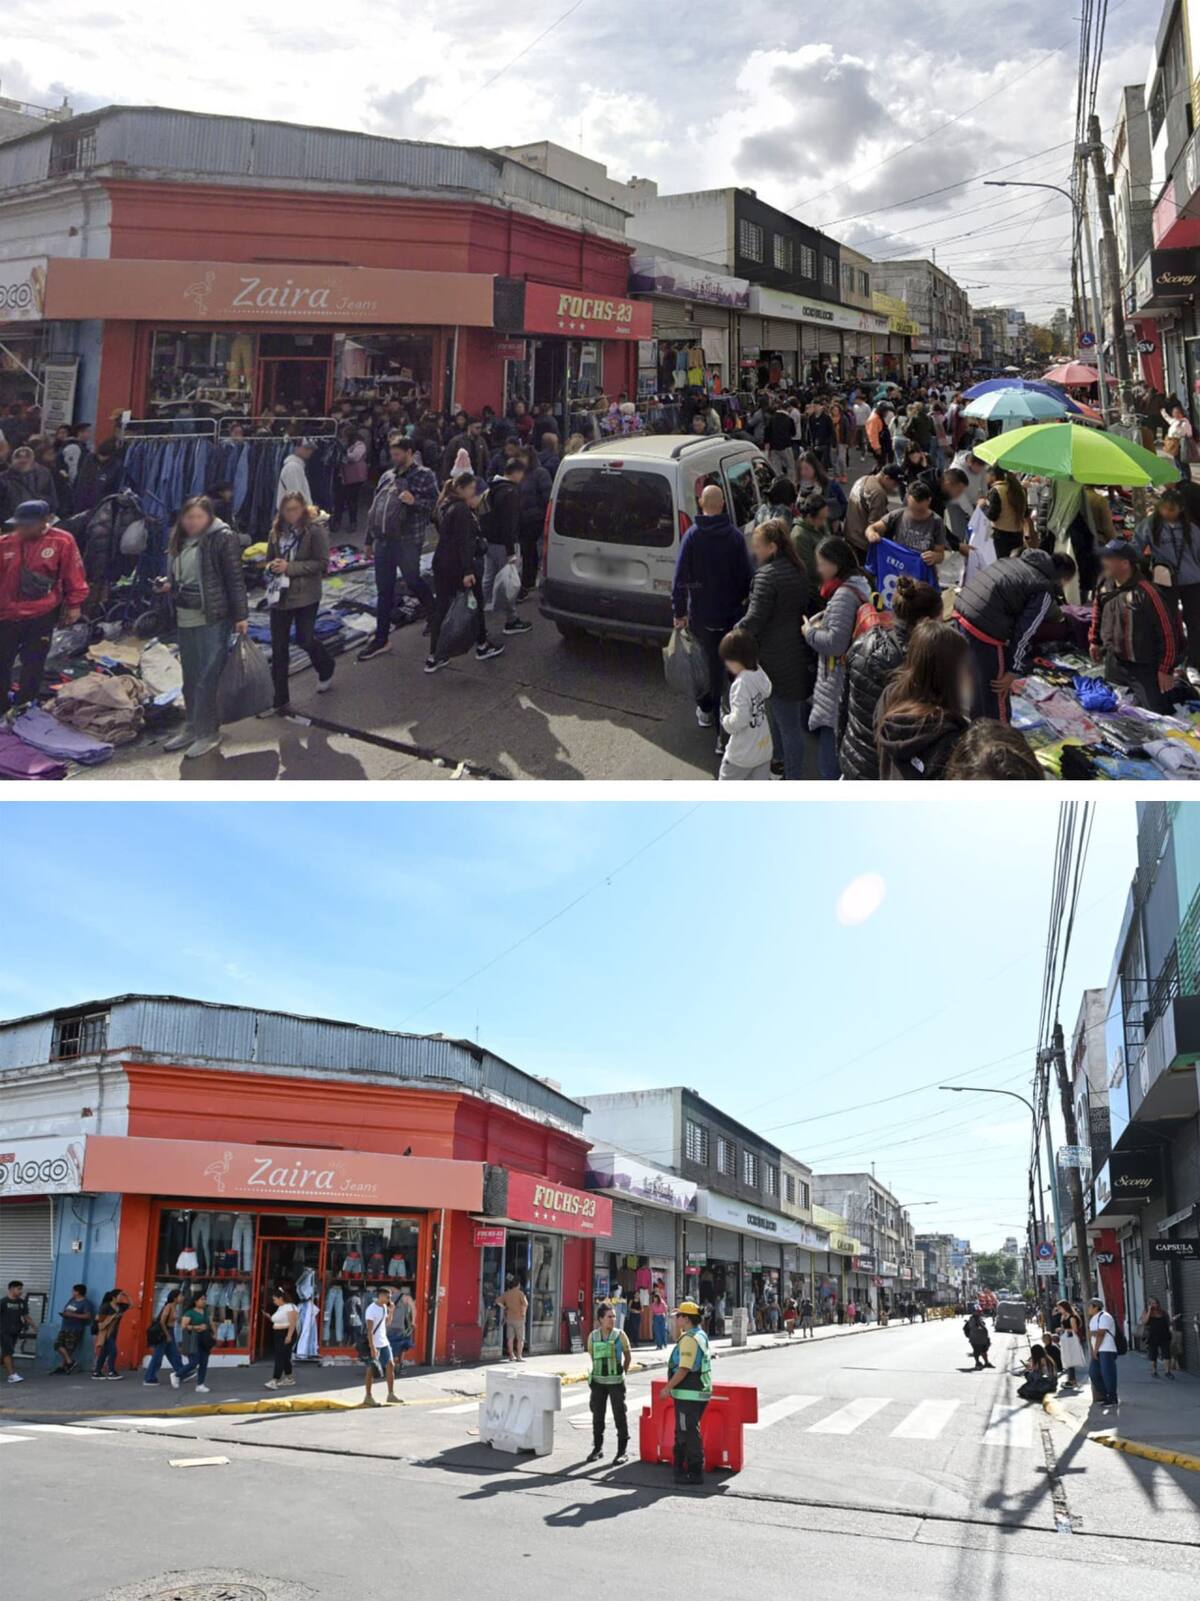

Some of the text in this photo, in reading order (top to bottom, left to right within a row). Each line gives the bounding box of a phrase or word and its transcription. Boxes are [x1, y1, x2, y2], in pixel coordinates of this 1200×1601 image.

[1155, 271, 1197, 286] Scony
[232, 276, 377, 310] Zaira Jeans
[557, 293, 633, 323] FOCHS-23
[886, 555, 905, 570] ENZO
[881, 574, 898, 610] 8
[13, 1158, 69, 1184] LOCO
[247, 1157, 378, 1193] Zaira Jeans
[1114, 1174, 1153, 1189] Scony
[532, 1184, 597, 1218] FOCHS-23
[1155, 1243, 1194, 1252] CAPSULA
